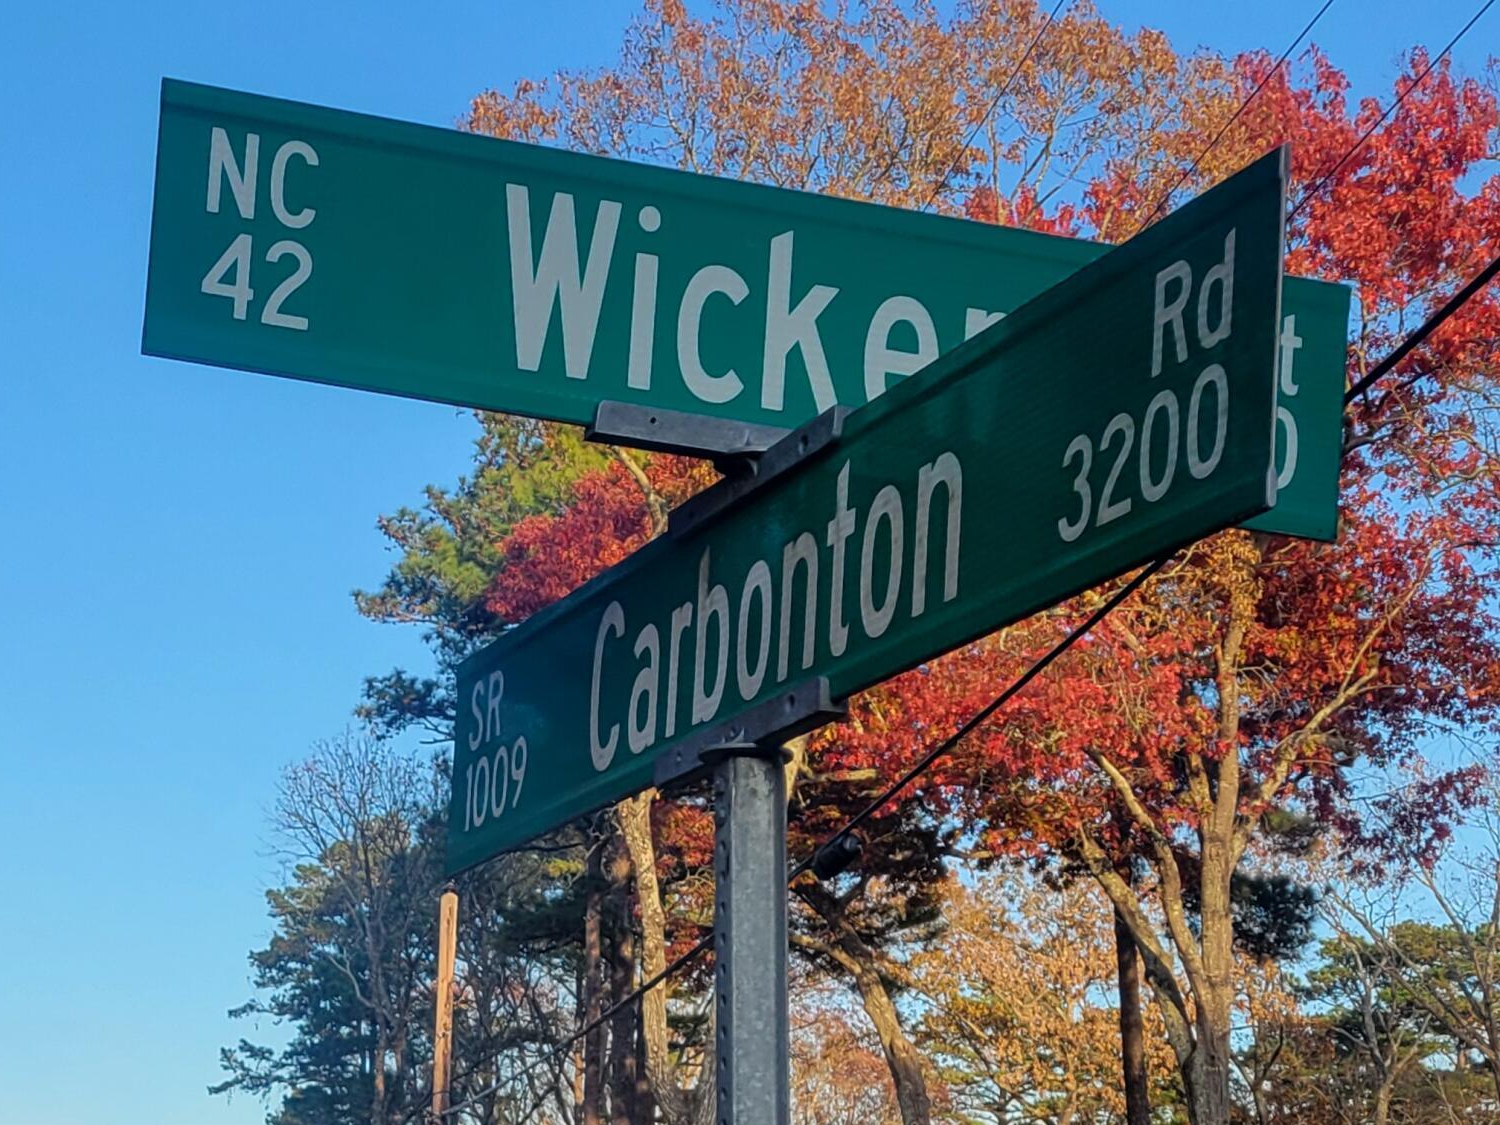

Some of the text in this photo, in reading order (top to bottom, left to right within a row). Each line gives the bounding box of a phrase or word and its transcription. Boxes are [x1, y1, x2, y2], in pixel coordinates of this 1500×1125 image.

[206, 127, 320, 229] NC
[201, 233, 314, 330] 42
[1151, 227, 1236, 378] Rd
[1057, 363, 1229, 542] 3200
[588, 451, 964, 772] Carbonton
[468, 670, 505, 751] SR
[464, 735, 528, 832] 1009
